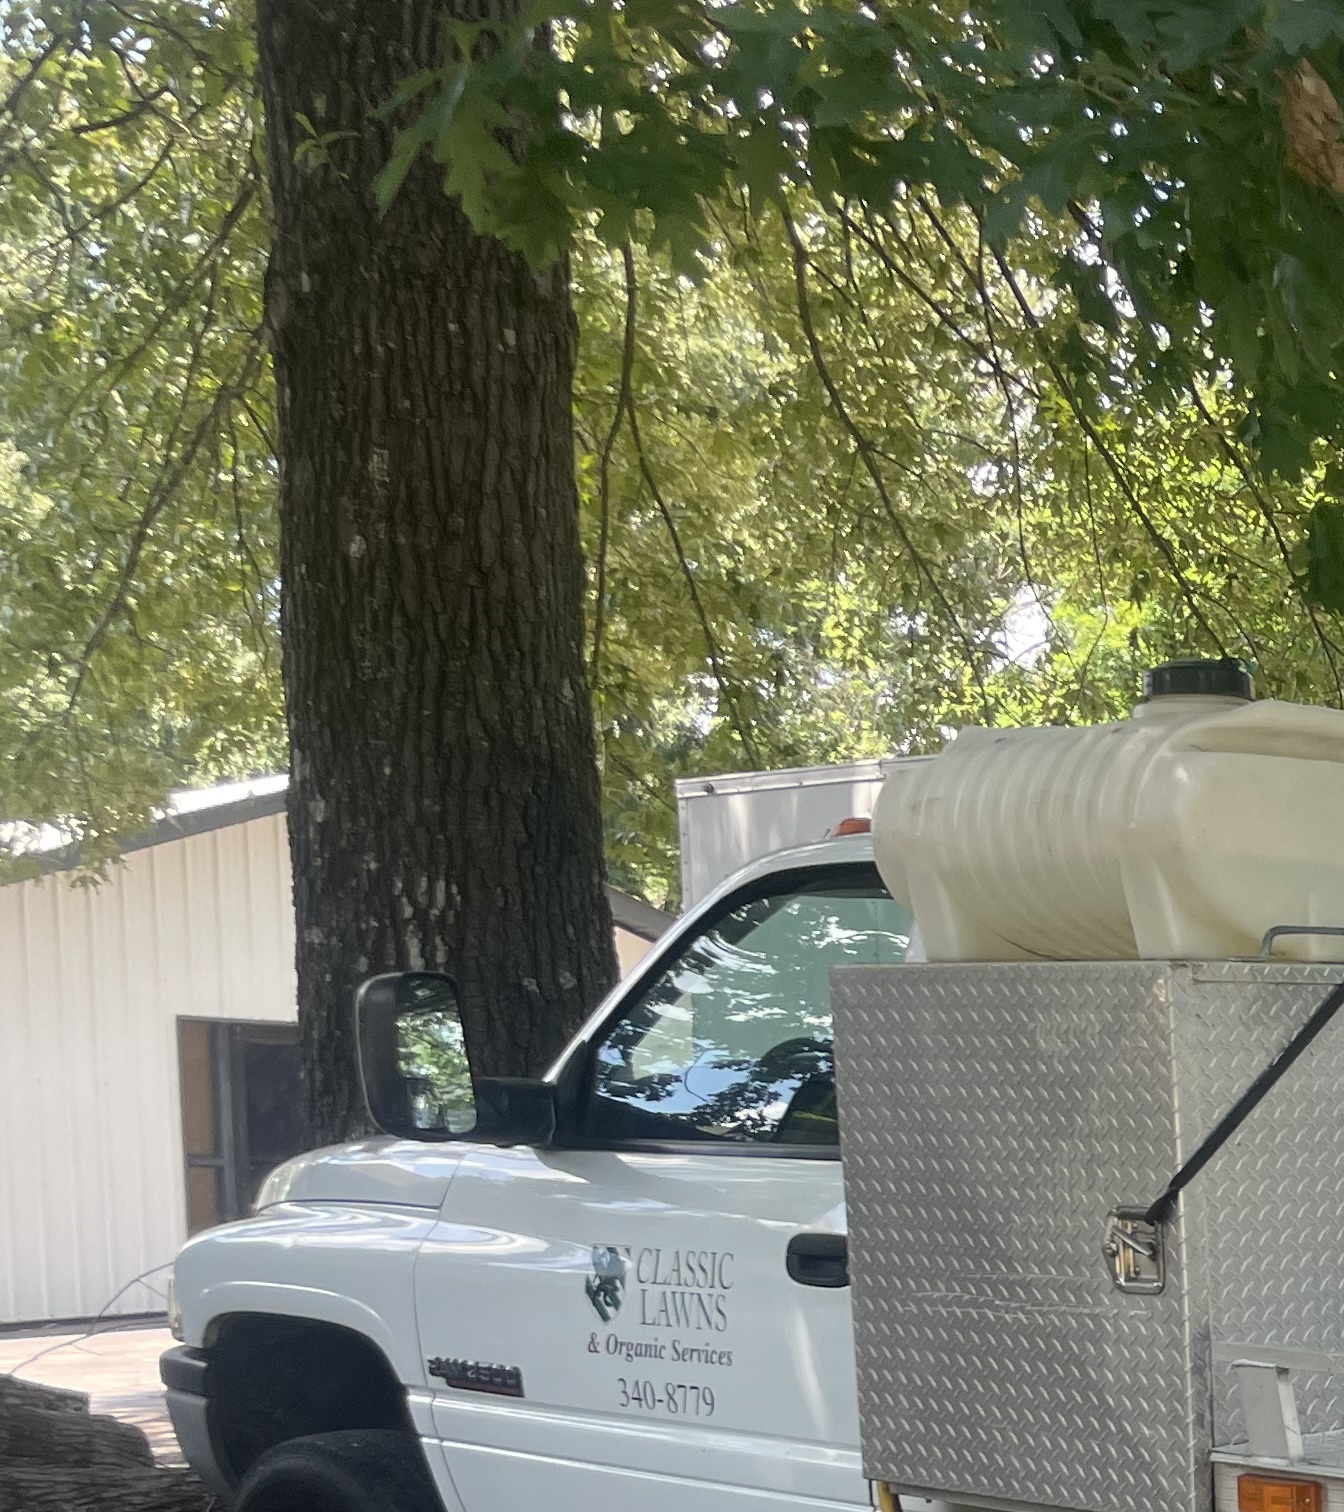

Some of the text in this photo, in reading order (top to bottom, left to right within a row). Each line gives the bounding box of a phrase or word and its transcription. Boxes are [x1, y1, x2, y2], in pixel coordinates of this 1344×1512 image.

[635, 1247, 736, 1291] CLASSIC
[639, 1285, 730, 1333] LAWNS
[587, 1331, 734, 1367] & Organic Services
[616, 1377, 717, 1418] 340-8779
